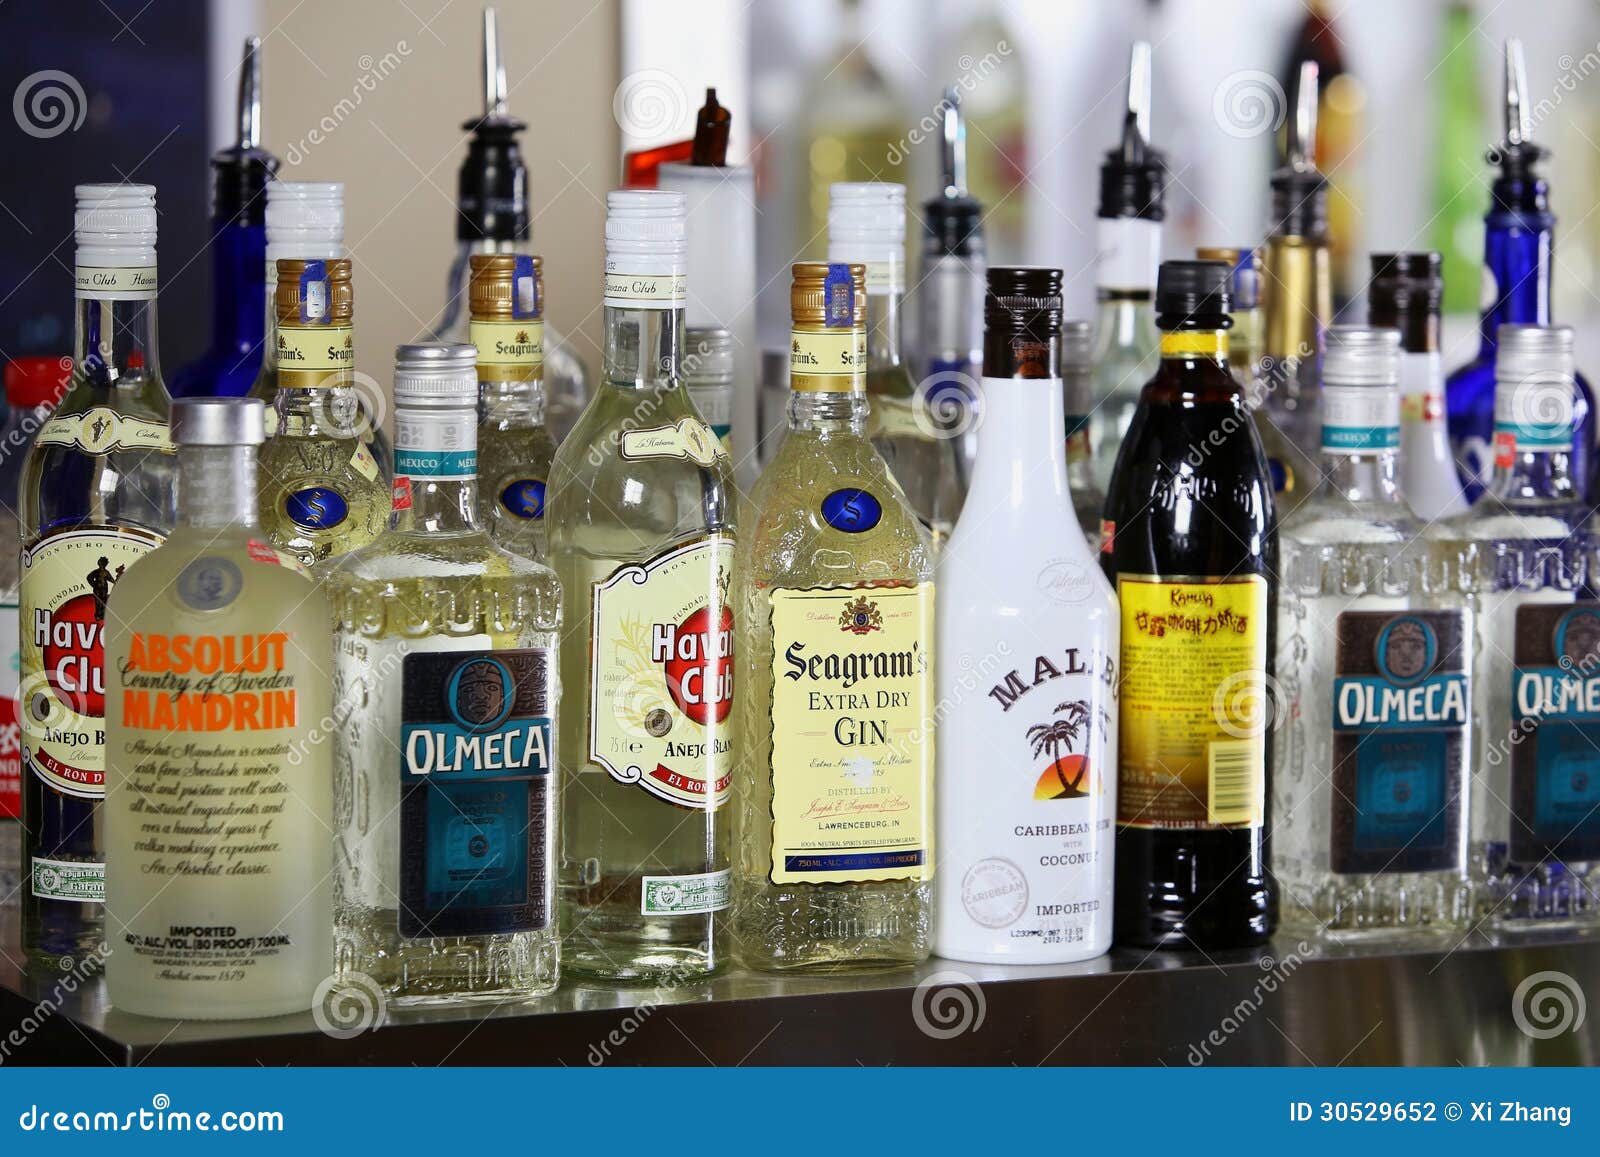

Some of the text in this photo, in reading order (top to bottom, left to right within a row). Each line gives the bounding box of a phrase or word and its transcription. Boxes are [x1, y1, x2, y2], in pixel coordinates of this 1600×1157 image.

[93, 273, 117, 286] Club
[632, 282, 657, 294] Club
[399, 458, 437, 468] MEXICO
[67, 542, 103, 551] PURO
[48, 583, 86, 608] FUNDADA
[127, 631, 290, 675] ABSOLUT
[784, 640, 928, 689] Seagram's
[117, 656, 295, 703] Country of Sweden
[122, 689, 296, 732] MANDRIN
[808, 690, 910, 711] EXTRA DRY
[1338, 675, 1467, 726] OLMECA
[43, 726, 90, 747] AÑEJO
[834, 716, 888, 747] GIN
[405, 725, 549, 776] OLMECA
[46, 757, 60, 773] EL
[64, 767, 88, 784] RON
[668, 774, 682, 787] EL
[1014, 822, 1090, 837] CARIBBEAN
[1036, 900, 1100, 917] IMPORTED
[169, 925, 237, 938] IMPORTED
[213, 937, 256, 950] PROOF)
